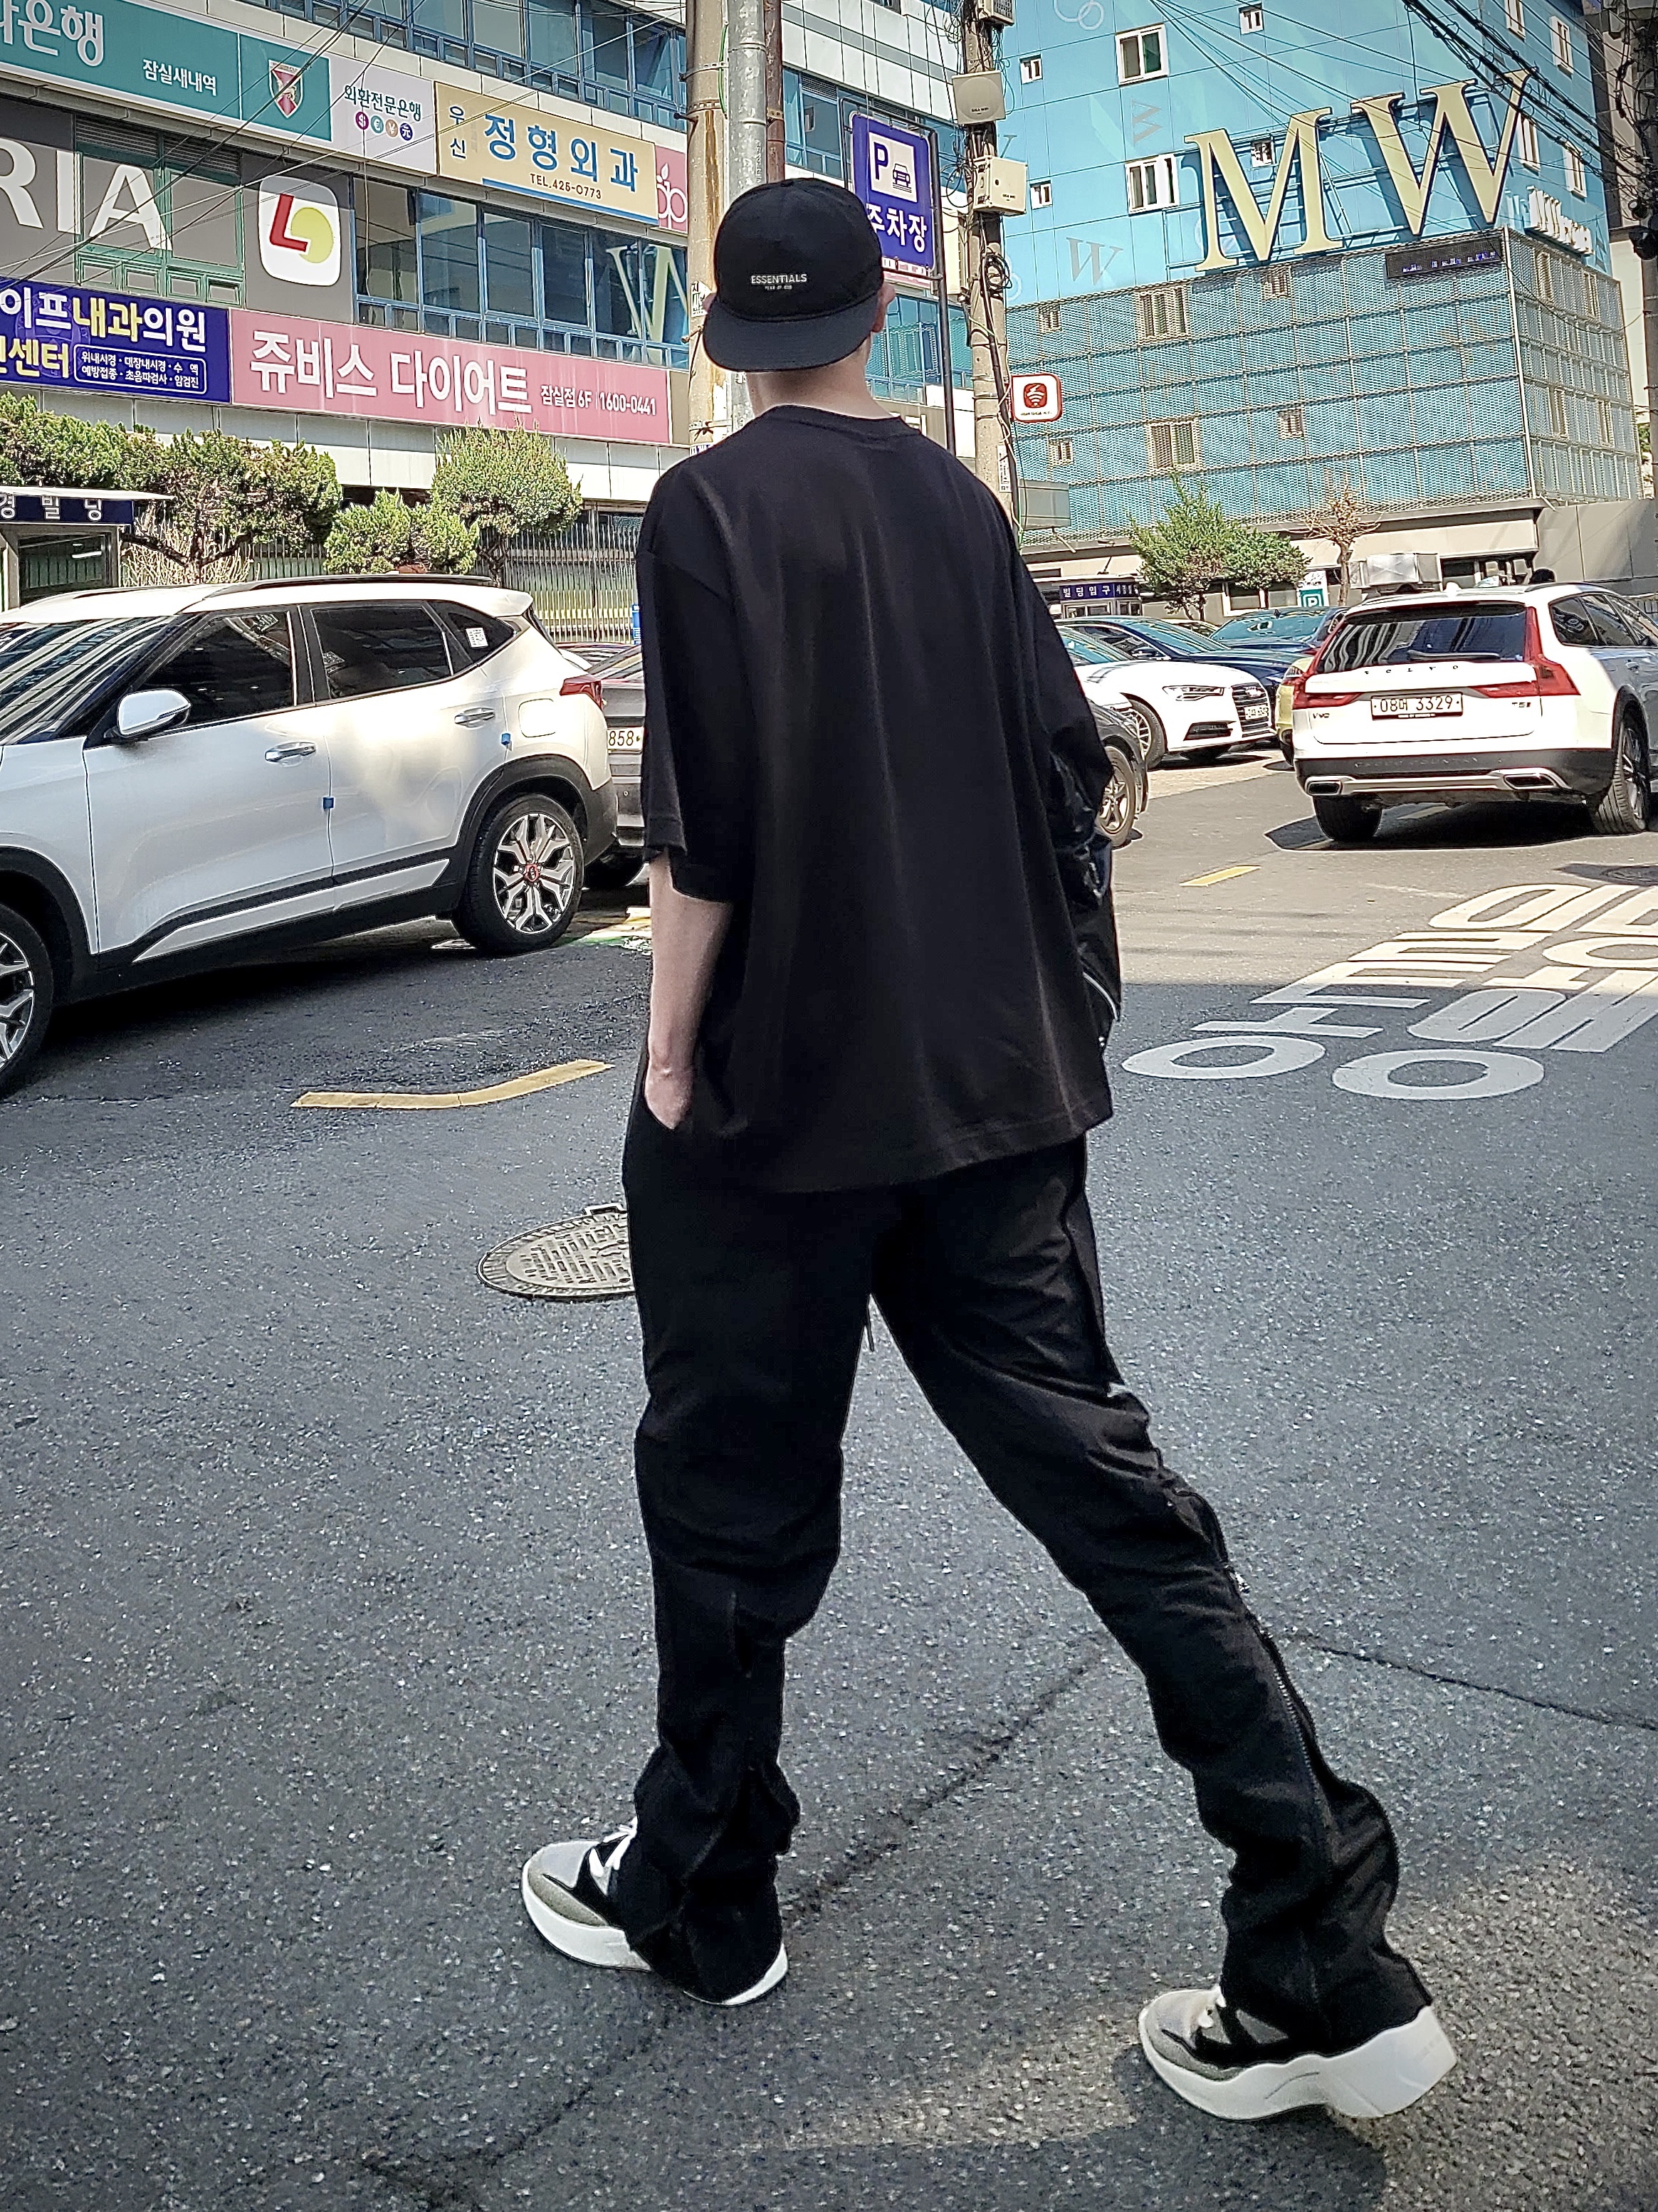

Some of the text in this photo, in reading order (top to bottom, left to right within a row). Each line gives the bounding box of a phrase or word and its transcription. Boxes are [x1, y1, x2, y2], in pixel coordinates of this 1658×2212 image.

[142, 58, 216, 97] 잠실새내역
[344, 85, 421, 122] 외환전문은행
[485, 113, 638, 193] 정형외과
[873, 141, 888, 181] P
[1184, 66, 1538, 272] MW
[0, 137, 173, 251] RIA
[866, 203, 927, 253] 주차장
[751, 273, 807, 284] ESSENTIALS
[0, 286, 206, 352] 이프내과의원
[81, 351, 116, 367] 위내시경
[124, 356, 167, 372] 대장내시경
[81, 364, 199, 389] 예방접종 초음파검사 암검진
[250, 330, 532, 416] 쥬비스 다이어트
[540, 385, 656, 416] 잠실점 6F 1600-0441
[1063, 585, 1111, 598] 빌딩입구
[1415, 695, 1453, 711] 3329
